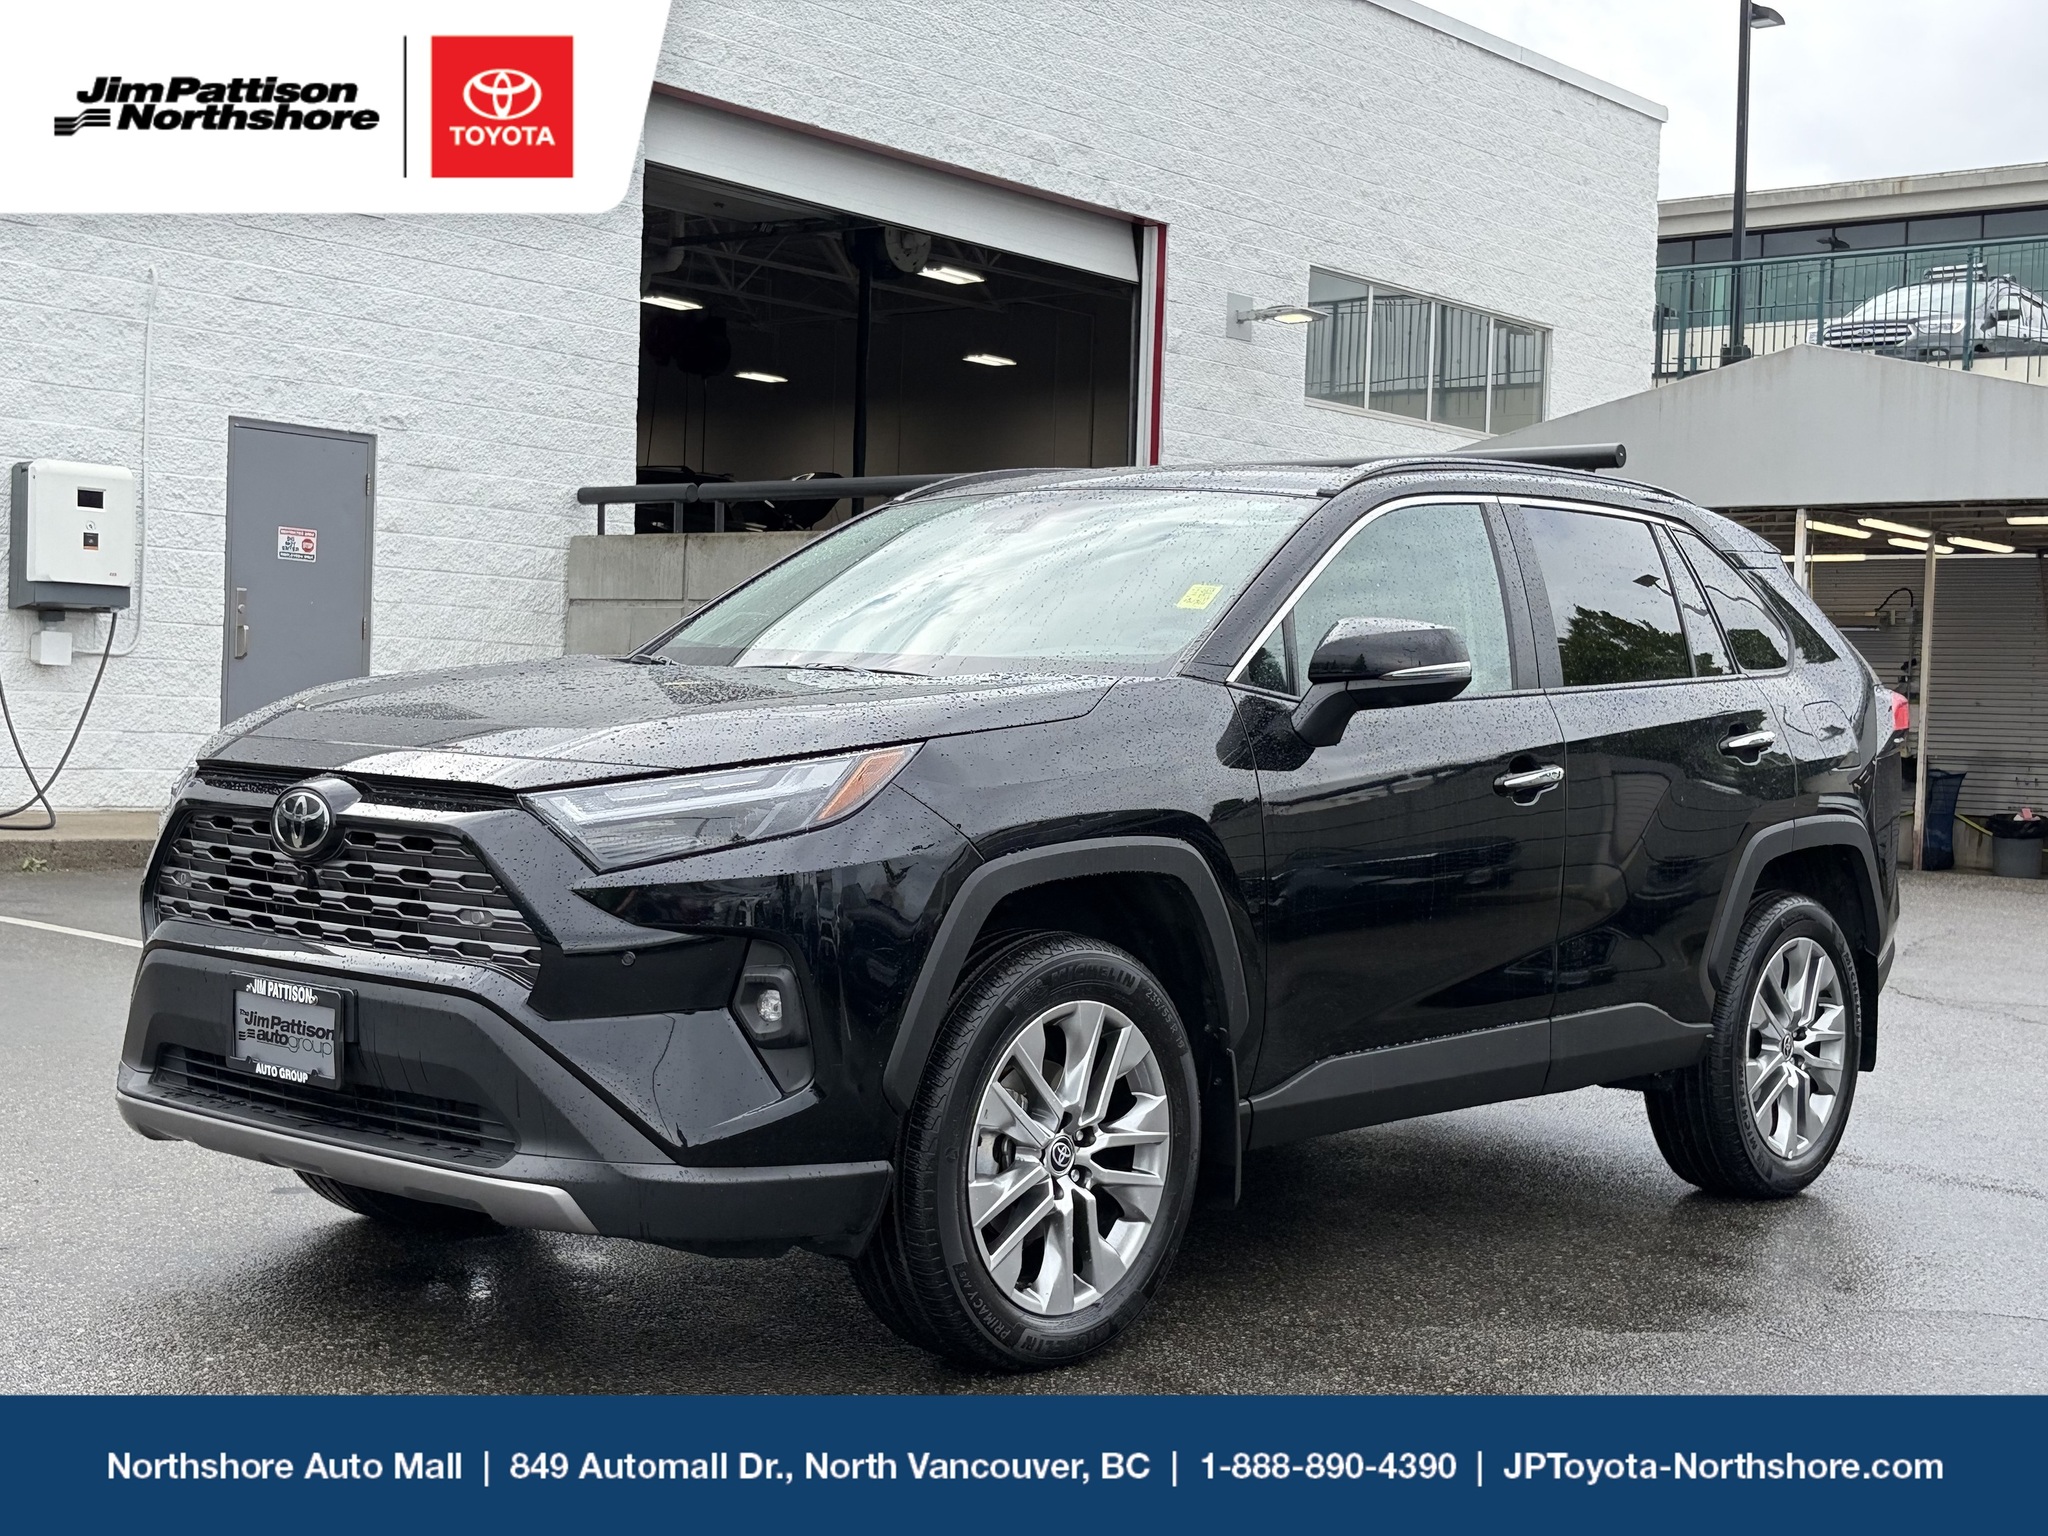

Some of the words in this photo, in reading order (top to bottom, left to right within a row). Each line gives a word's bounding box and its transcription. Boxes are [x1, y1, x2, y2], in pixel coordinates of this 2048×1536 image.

[1051, 963, 1137, 990] MICHELIN
[250, 978, 267, 996] JIM
[267, 981, 314, 1005] PATTISON
[255, 1062, 278, 1078] AUTO
[278, 1067, 309, 1084] GROUP
[968, 1290, 1012, 1341] PRIMACY
